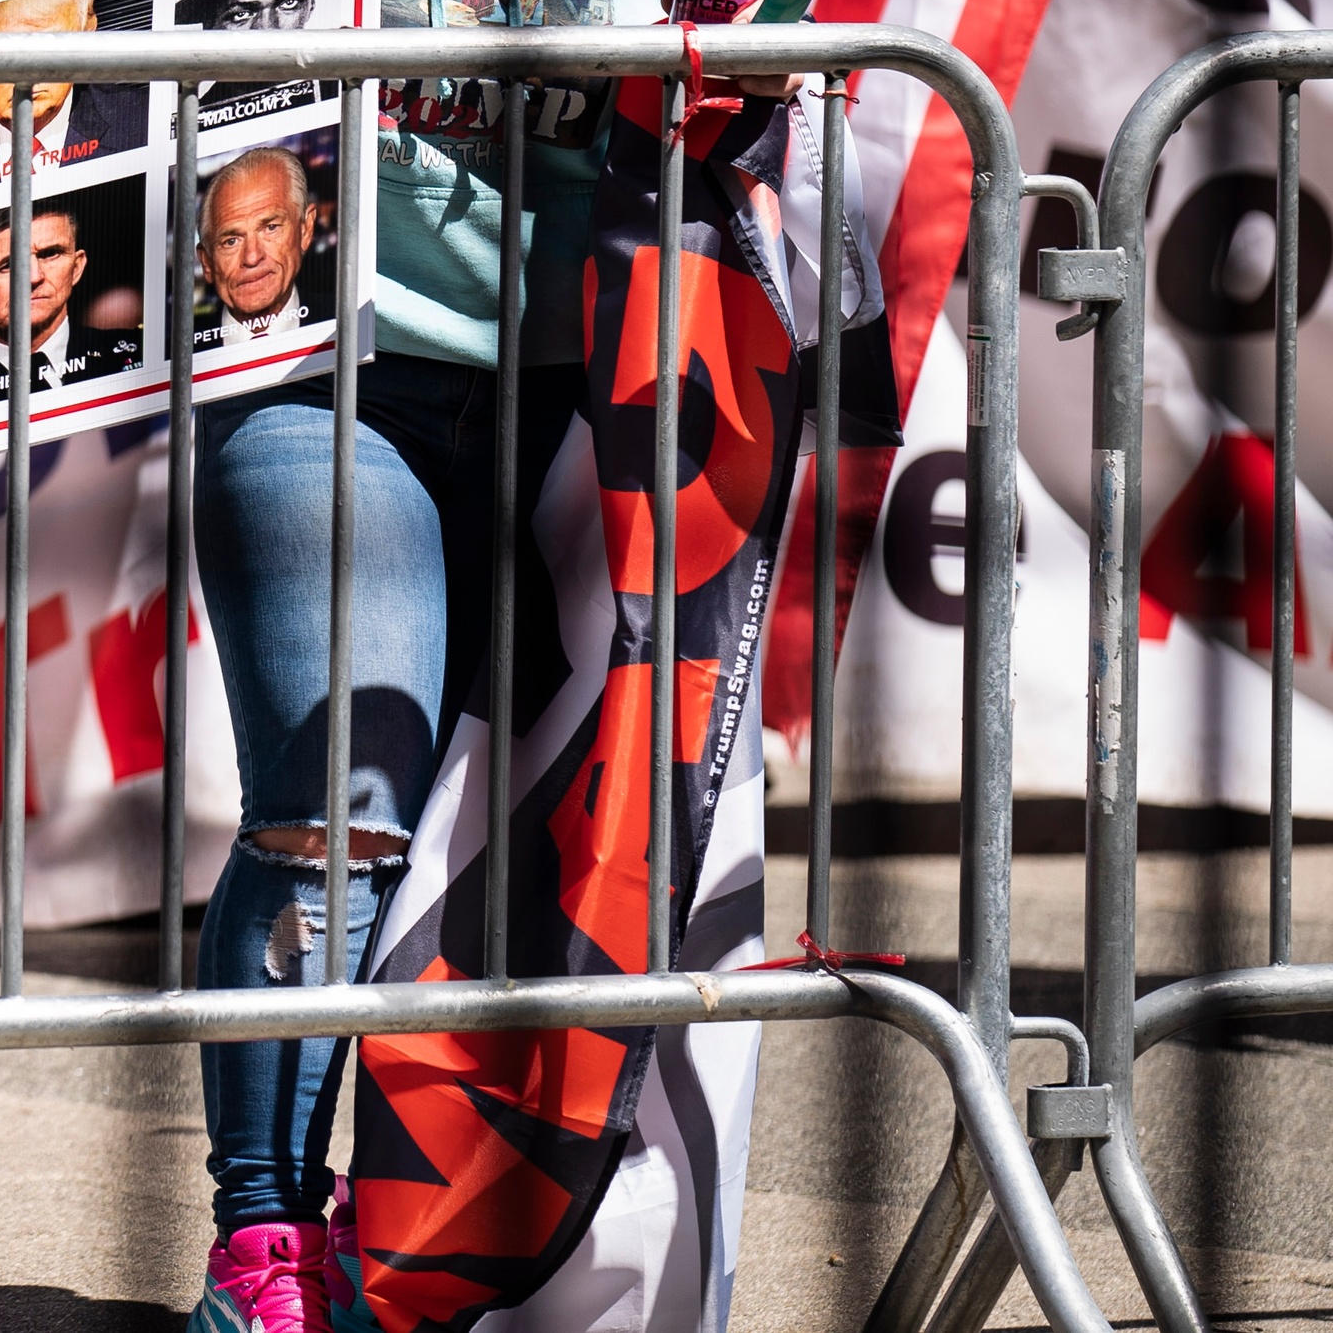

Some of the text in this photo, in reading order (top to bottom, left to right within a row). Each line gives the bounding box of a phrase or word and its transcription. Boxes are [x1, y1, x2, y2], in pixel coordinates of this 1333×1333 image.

[202, 94, 278, 127] MALCOLM
[40, 139, 100, 167] TRUMP
[418, 140, 491, 169] WITH
[193, 305, 310, 345] PETER NAVARRO
[708, 558, 770, 779] TrumpSwag.com
